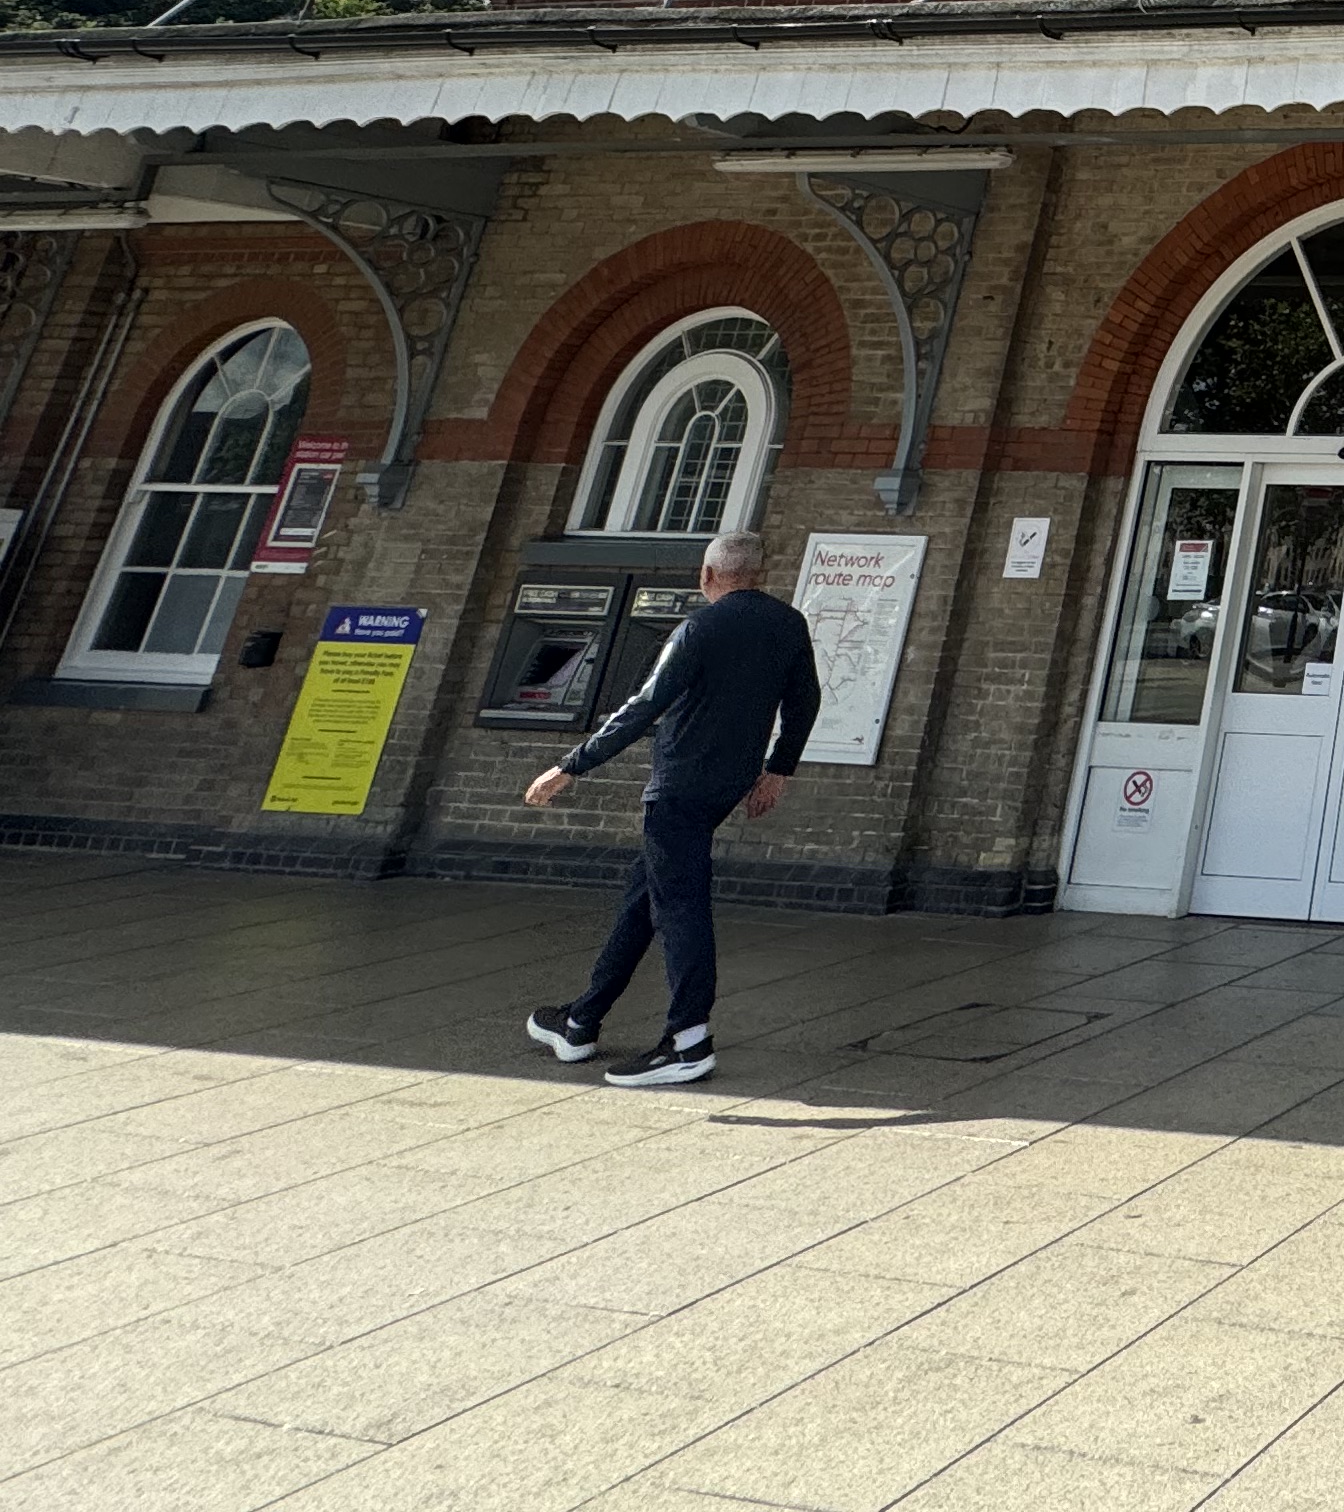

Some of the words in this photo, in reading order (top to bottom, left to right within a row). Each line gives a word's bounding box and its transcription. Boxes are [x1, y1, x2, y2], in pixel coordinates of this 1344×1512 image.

[813, 549, 886, 569] Network
[808, 571, 854, 587] route
[855, 574, 896, 590] map
[358, 614, 411, 628] WARNING
